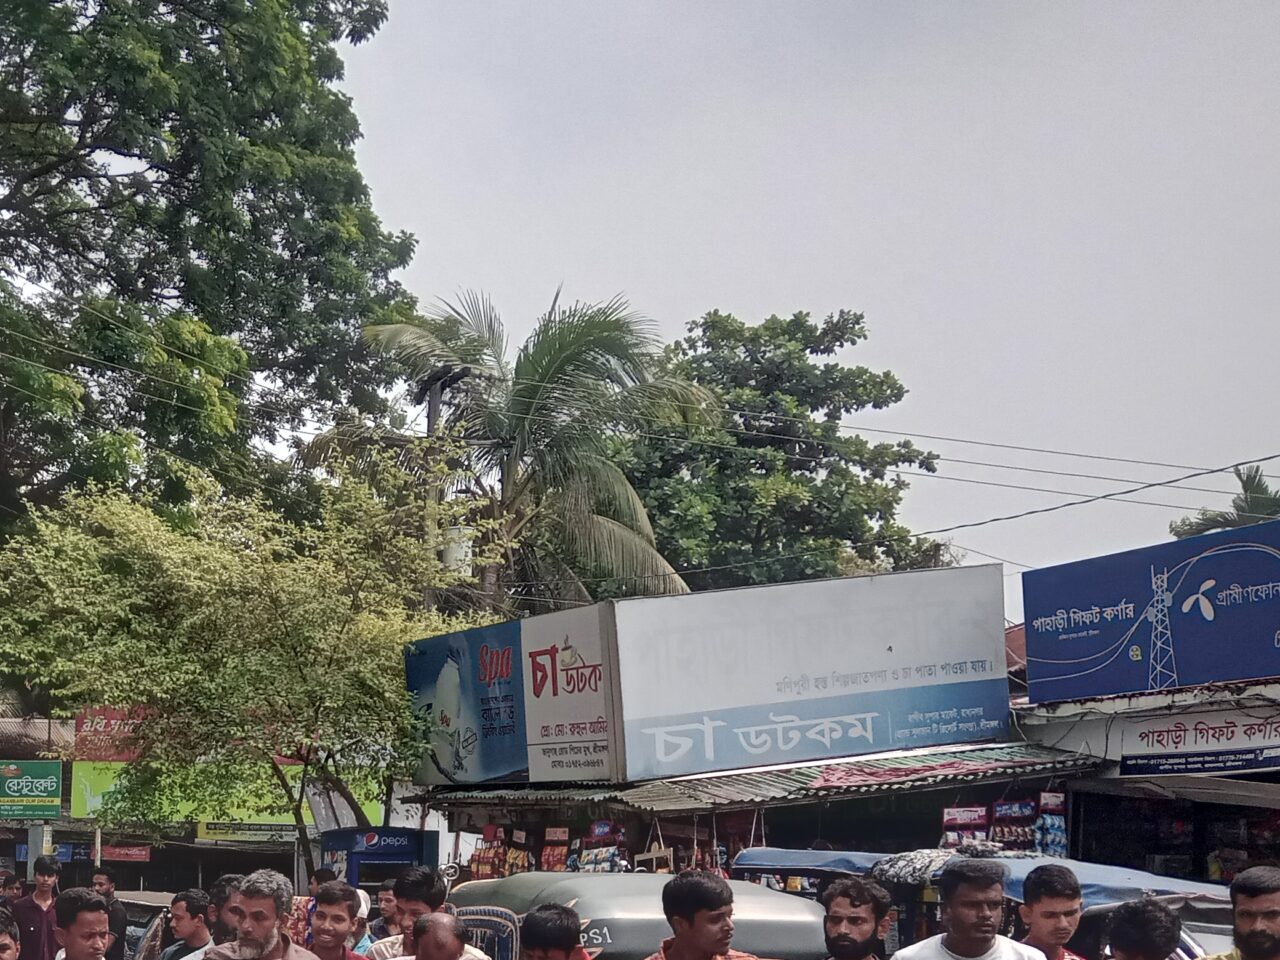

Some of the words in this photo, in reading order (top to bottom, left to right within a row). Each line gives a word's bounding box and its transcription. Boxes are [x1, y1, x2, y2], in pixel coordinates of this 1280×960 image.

[1032, 609, 1068, 633] পাহাড়ী
[1070, 607, 1101, 628] গিফট
[479, 644, 512, 688] Spa
[529, 644, 559, 698] চা
[915, 664, 937, 678] পাতা
[940, 661, 968, 676] পাওয়া
[641, 716, 728, 762] চা
[733, 712, 879, 753] ডটকম
[1139, 722, 1189, 749] পাহাড়ী
[1193, 719, 1237, 744] গিফট
[380, 835, 408, 846] pepsi
